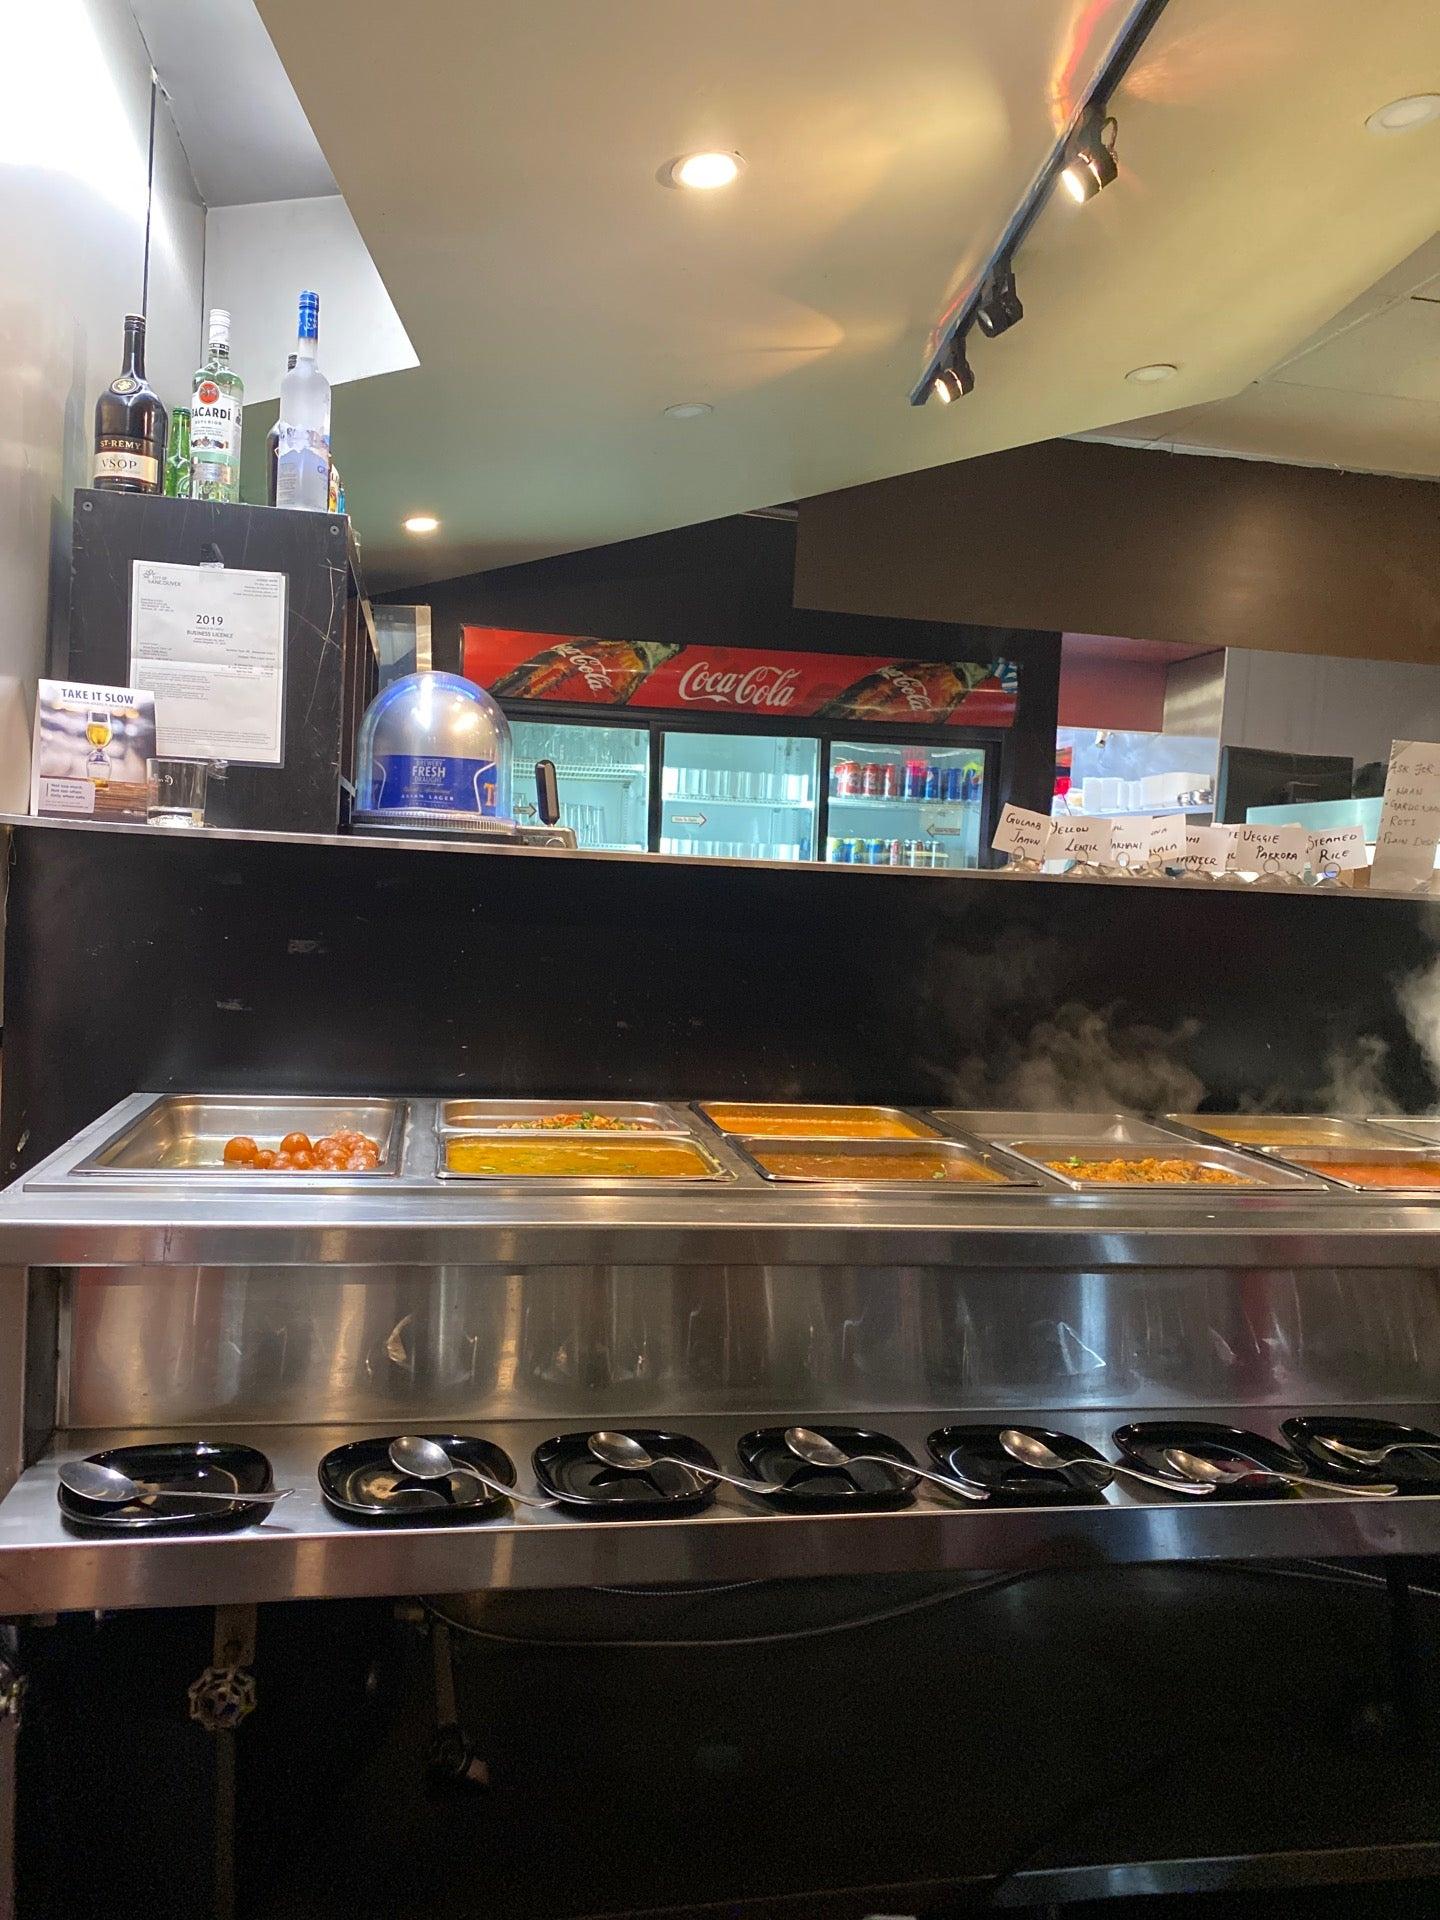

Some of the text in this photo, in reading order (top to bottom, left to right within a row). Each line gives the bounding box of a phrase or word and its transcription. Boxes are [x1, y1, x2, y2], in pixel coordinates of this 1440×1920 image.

[102, 458, 137, 469] VSOP
[196, 614, 224, 625] 2019
[61, 688, 89, 700] TAKE
[92, 692, 102, 701] IT
[105, 693, 135, 705] SLOW
[412, 766, 446, 778] FRESH
[1005, 812, 1042, 831] GULAAB
[1050, 821, 1090, 835] YELLOW
[1009, 827, 1041, 847] JAMUN
[1243, 830, 1280, 844] VEGGIE
[1306, 833, 1358, 854] STEAMED
[1318, 848, 1351, 863] RICE
